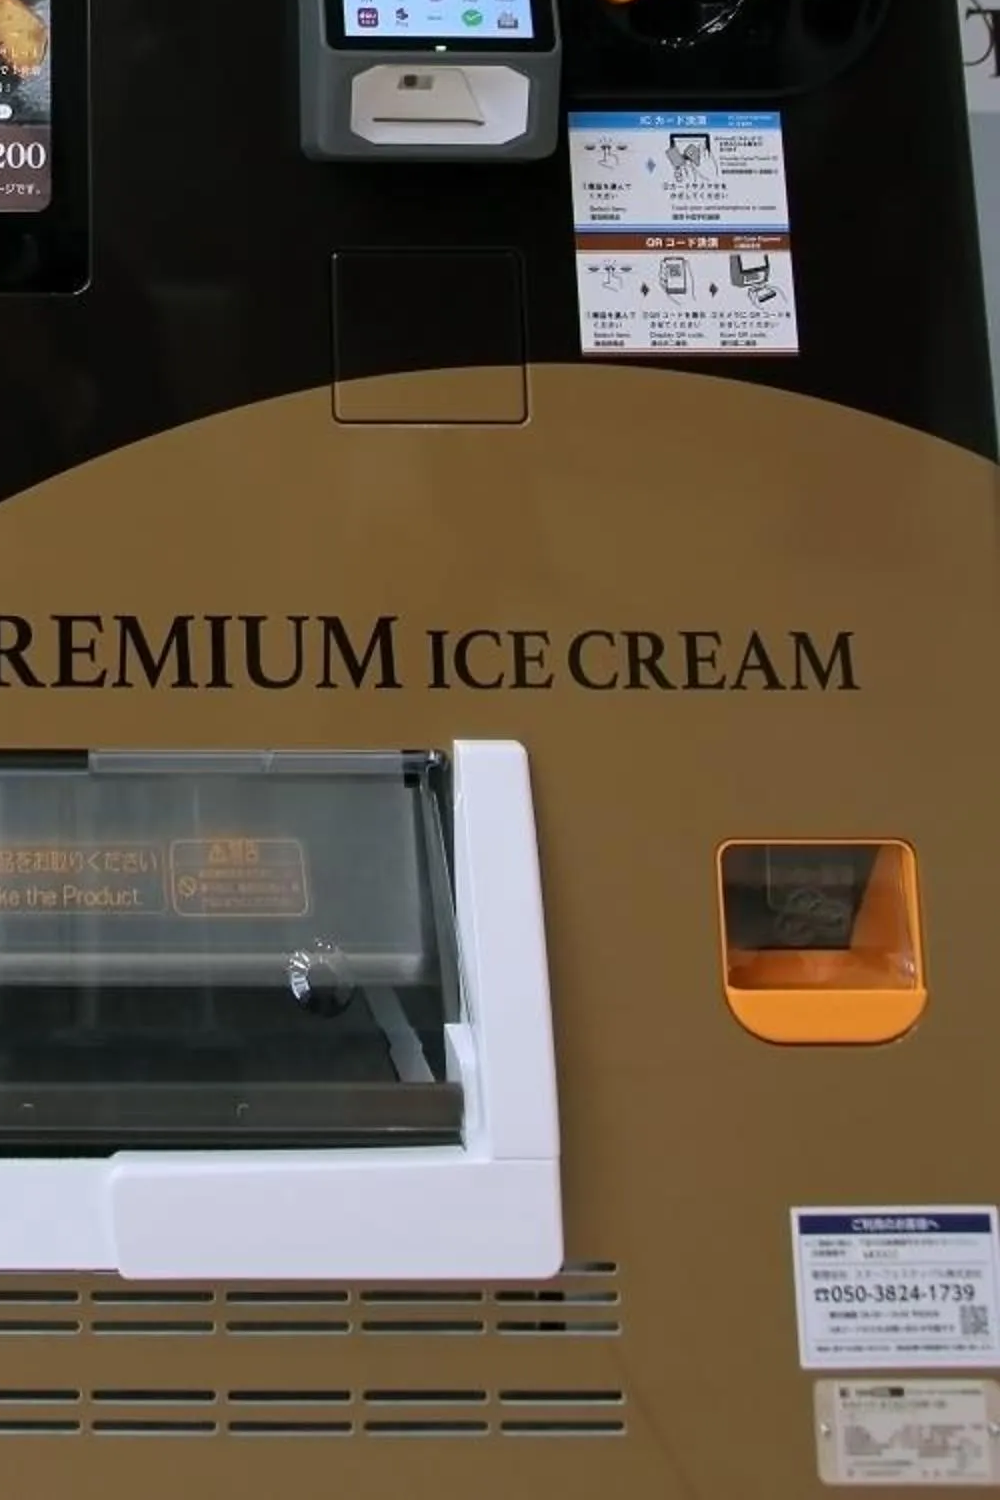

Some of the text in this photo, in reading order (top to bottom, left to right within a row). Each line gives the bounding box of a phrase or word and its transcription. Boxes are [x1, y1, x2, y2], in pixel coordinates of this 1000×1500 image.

[427, 630, 555, 690] ICE
[567, 630, 859, 691] CREAM
[27, 884, 59, 906] the
[830, 1283, 976, 1303] 050-3824-1739
